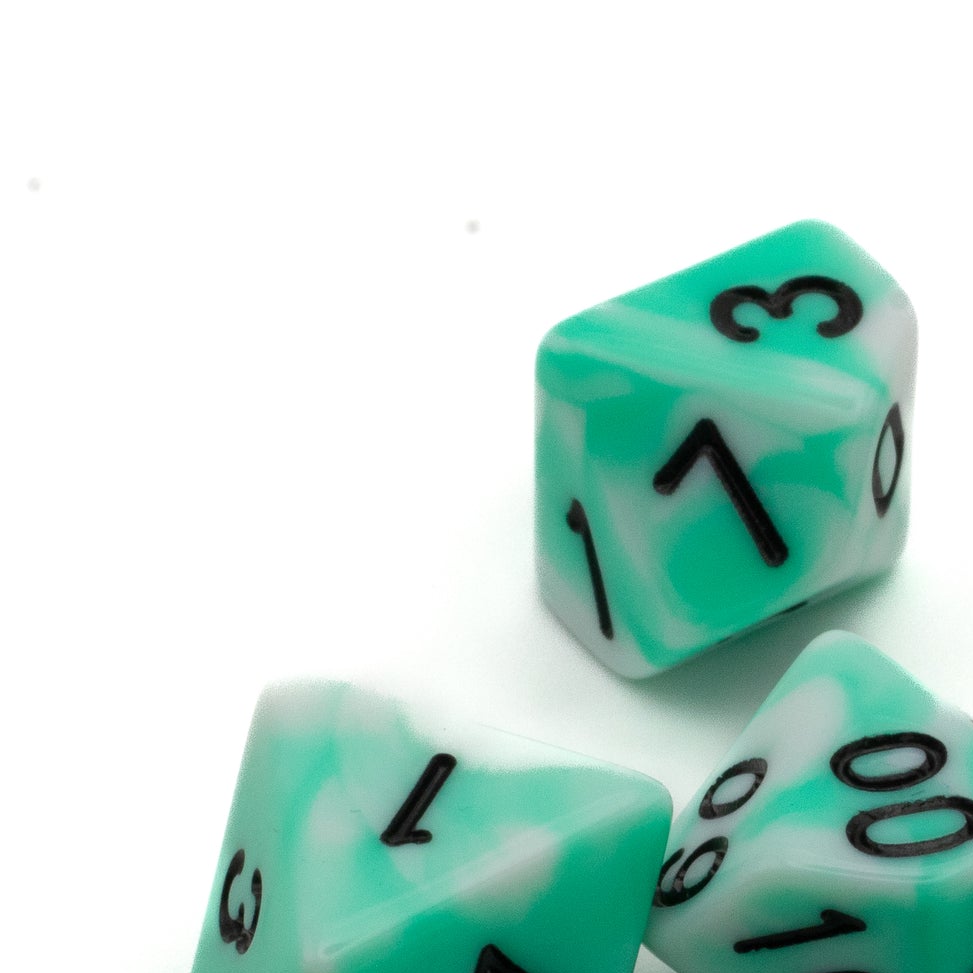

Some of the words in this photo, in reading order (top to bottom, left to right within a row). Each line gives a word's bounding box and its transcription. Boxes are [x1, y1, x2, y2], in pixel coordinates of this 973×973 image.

[709, 275, 864, 343] 3
[653, 417, 790, 569] 7
[871, 402, 905, 518] 0
[565, 497, 614, 641] 1
[379, 753, 457, 848] 1
[218, 849, 263, 956] 3
